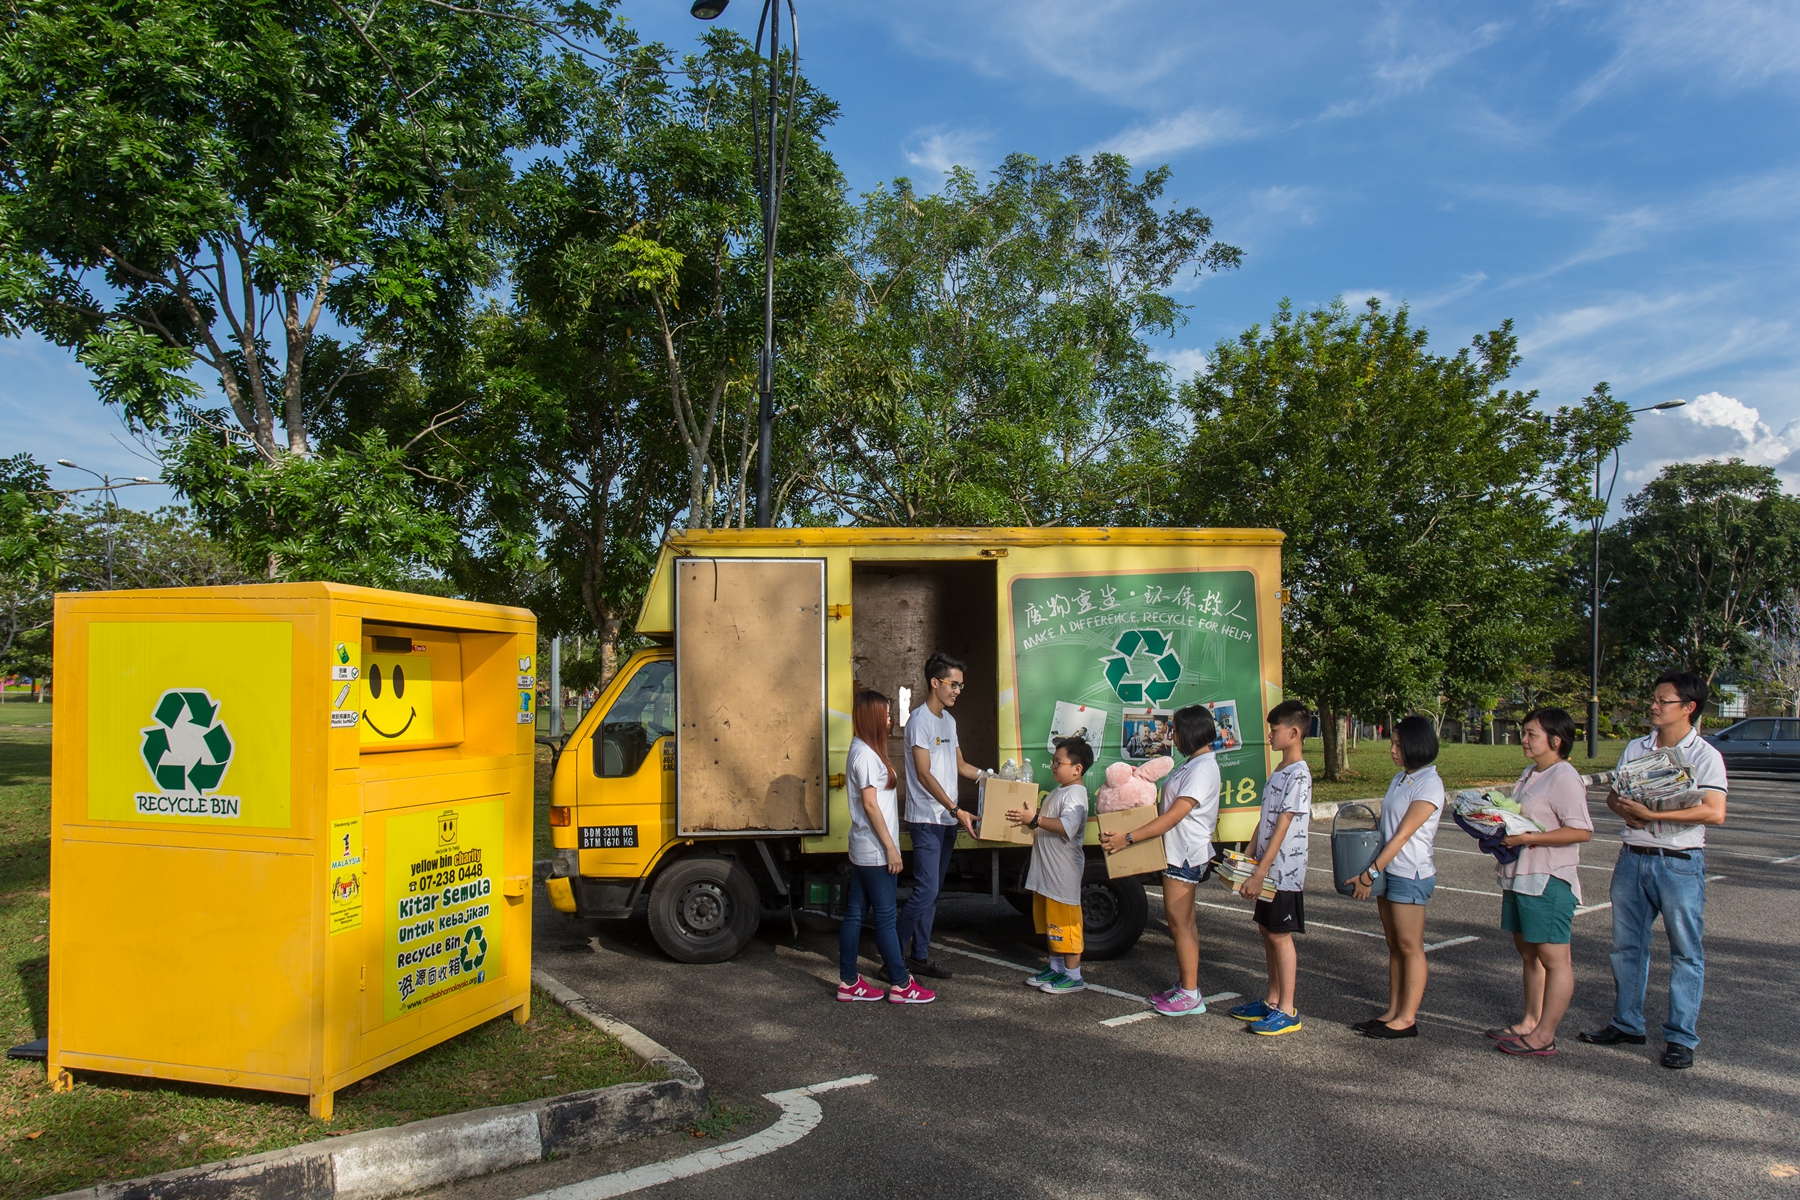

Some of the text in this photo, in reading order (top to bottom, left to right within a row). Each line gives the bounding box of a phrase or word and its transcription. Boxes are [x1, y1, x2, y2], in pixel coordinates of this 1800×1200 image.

[1022, 628, 1056, 650] MAKE
[1059, 624, 1067, 636] A
[1142, 612, 1196, 627] RECYCLE
[1198, 618, 1219, 633] FOR
[1221, 624, 1253, 643] HELP!
[136, 795, 238, 815] RECYCLE BIN
[1219, 777, 1258, 805] 48
[583, 826, 634, 838] BDM 3300 KG
[584, 836, 634, 848] BTM 1670 KG
[331, 856, 361, 869] MALAYSIA
[410, 847, 482, 877] yellow bin charity
[419, 862, 483, 892] 07-238 0448
[400, 894, 440, 919] Kitar
[399, 904, 490, 943] Untuk Kebajikan
[397, 935, 461, 969] Recycle Bin
[397, 955, 461, 1002] 资源回收箱
[854, 987, 868, 998] N
[406, 976, 478, 1011] www.amitabhamalaysia.org
[908, 989, 921, 1000] N
